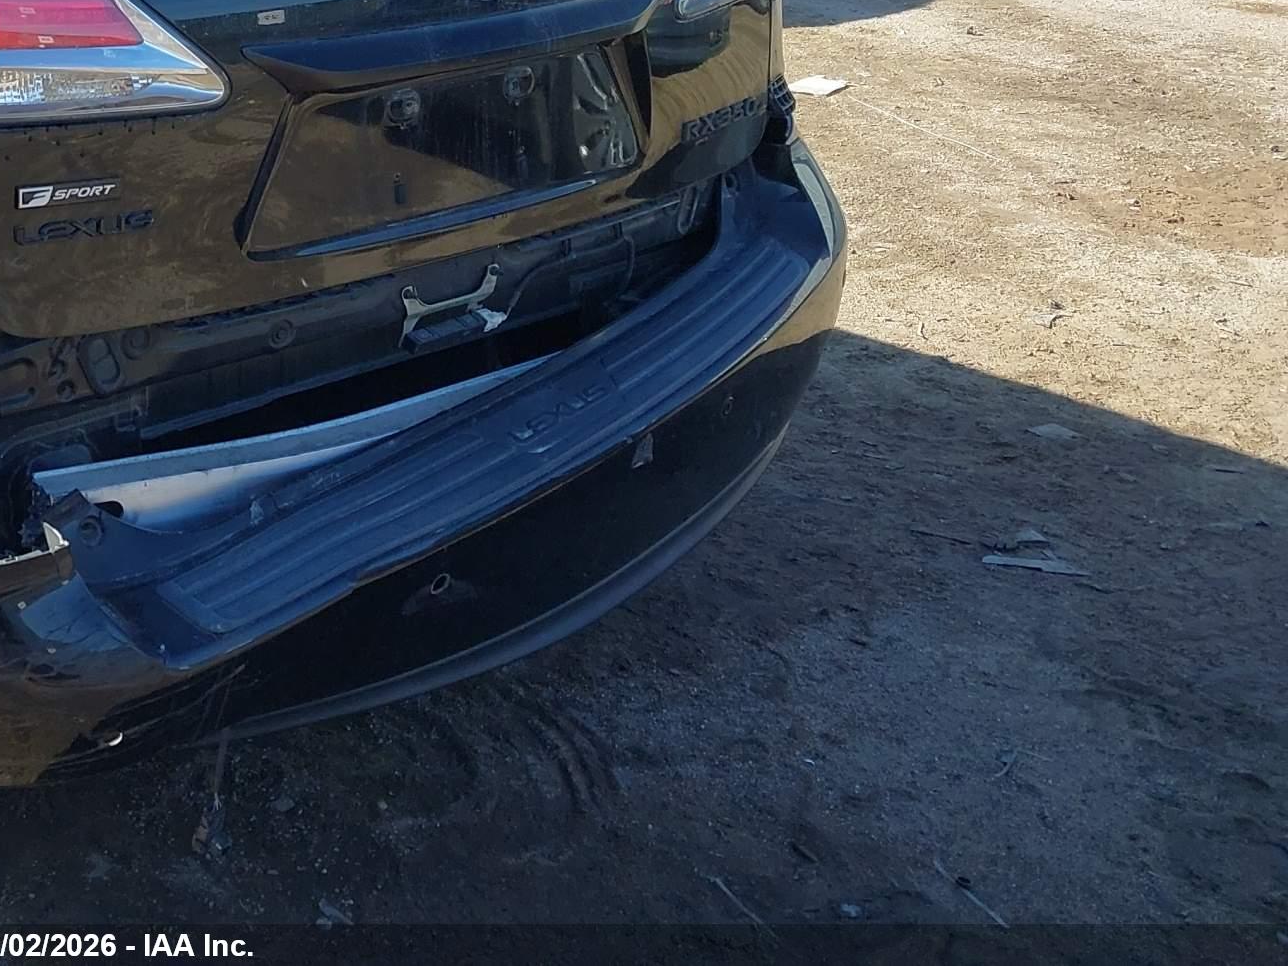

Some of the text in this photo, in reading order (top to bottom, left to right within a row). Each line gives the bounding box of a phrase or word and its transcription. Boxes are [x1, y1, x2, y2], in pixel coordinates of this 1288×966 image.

[53, 184, 116, 201] SPORT
[13, 210, 154, 246] LEXUS
[508, 385, 607, 444] LEXUS
